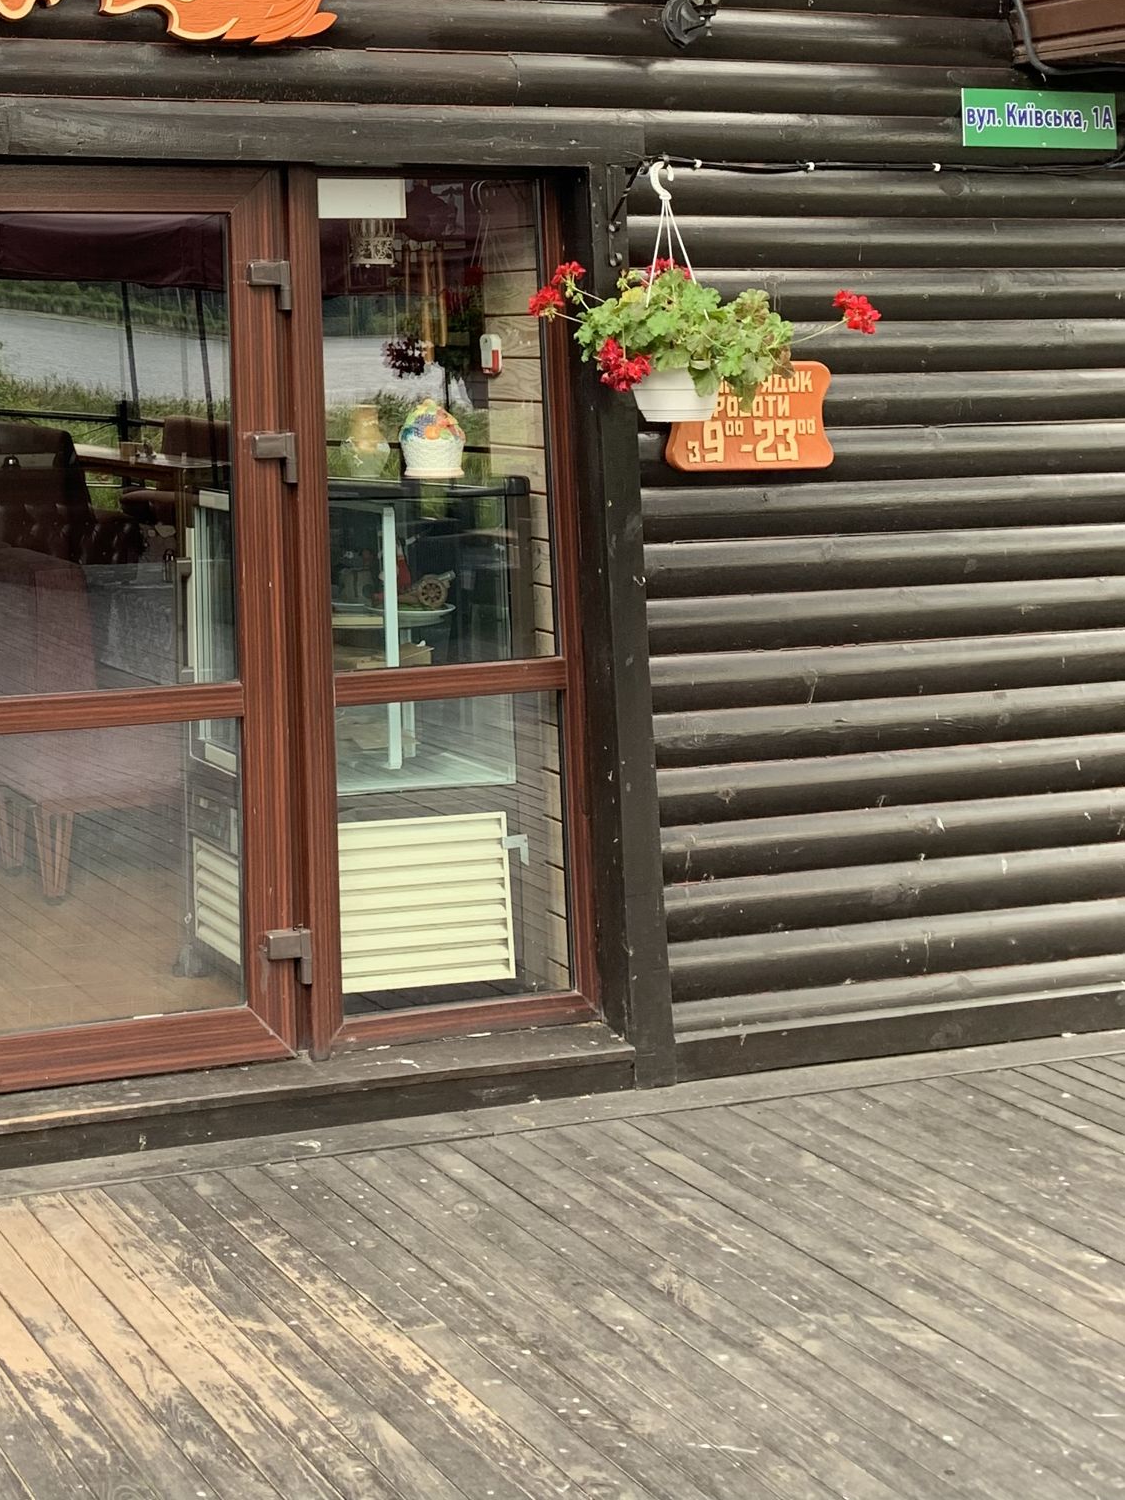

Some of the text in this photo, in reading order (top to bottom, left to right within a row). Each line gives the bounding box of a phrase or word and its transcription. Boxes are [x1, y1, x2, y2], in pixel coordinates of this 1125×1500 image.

[966, 102, 1115, 132] вул. Київська, 1А
